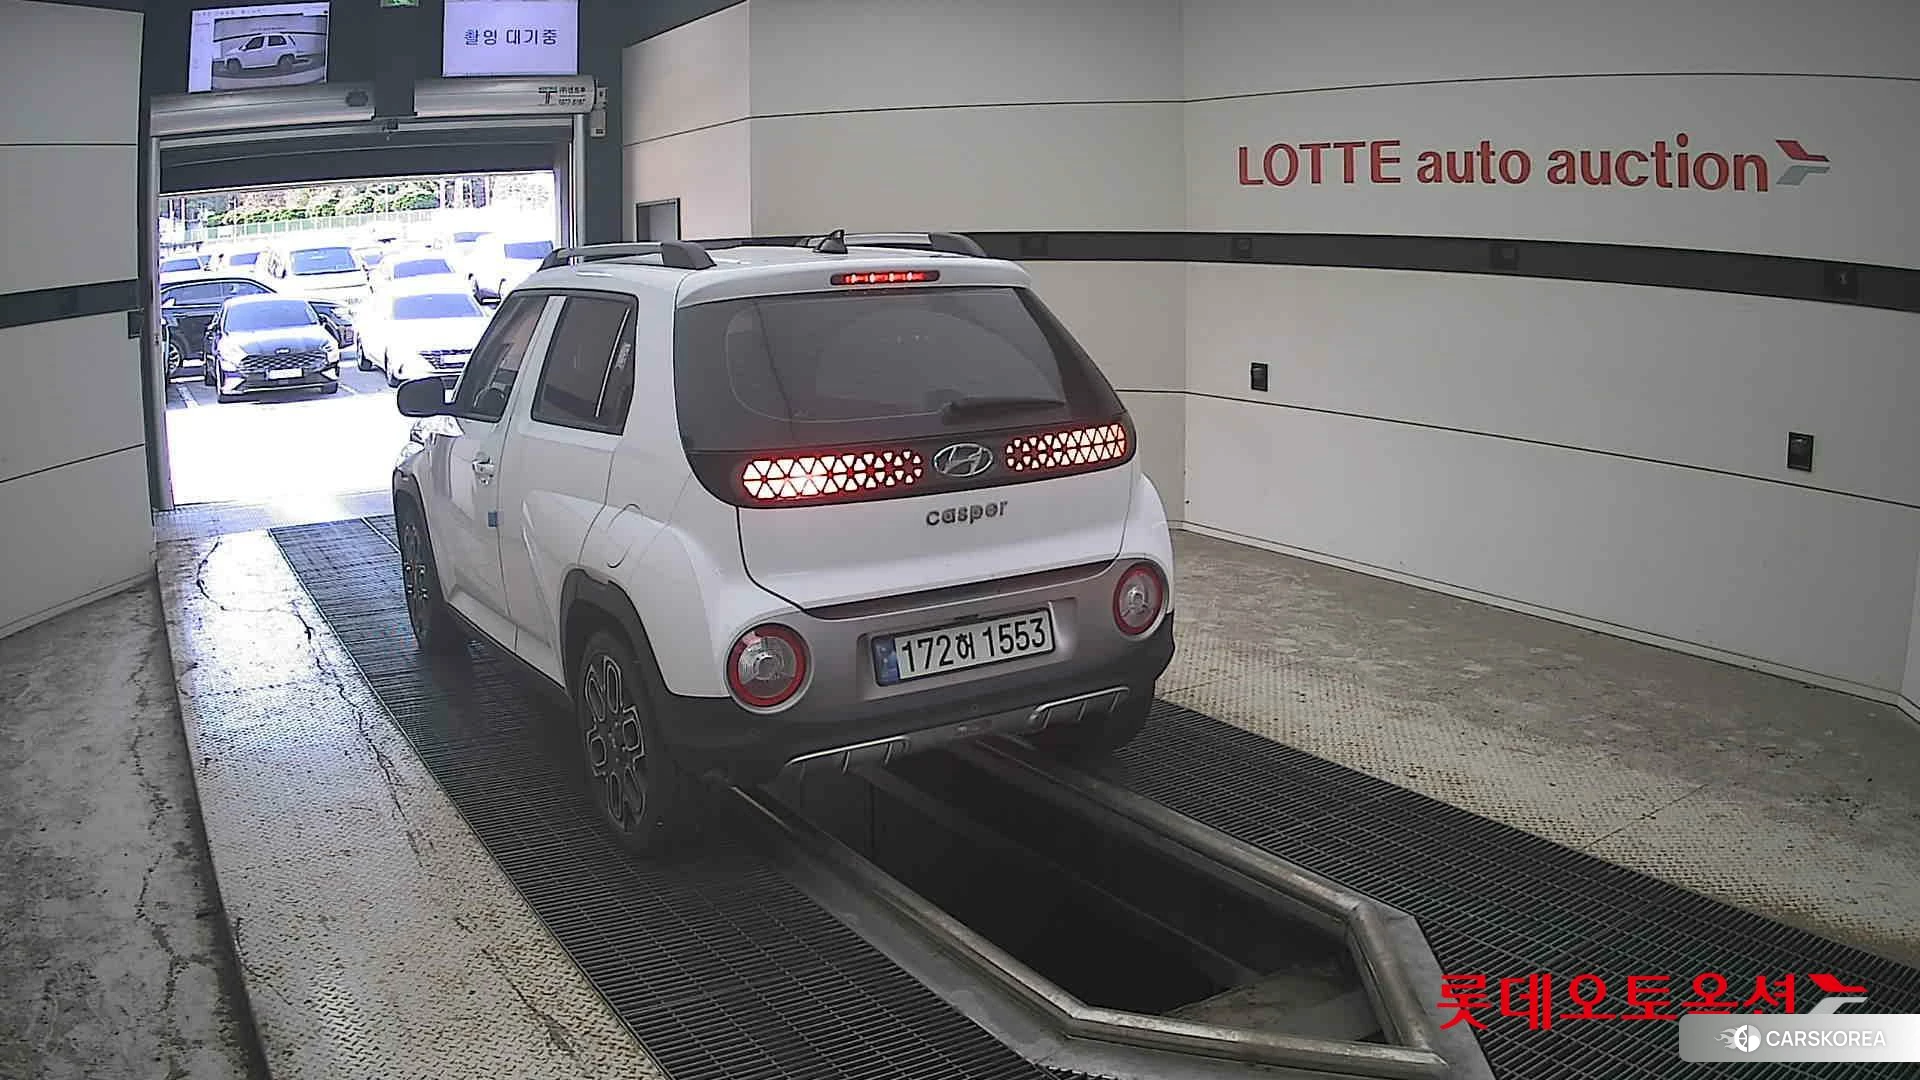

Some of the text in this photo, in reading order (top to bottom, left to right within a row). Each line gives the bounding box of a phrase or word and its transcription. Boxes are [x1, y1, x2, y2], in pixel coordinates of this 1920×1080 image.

[464, 29, 558, 46] 촬영 대기중
[1238, 133, 1769, 192] LOTTE auto auction
[925, 500, 1008, 527] casper
[901, 617, 1046, 673] 172허 1553
